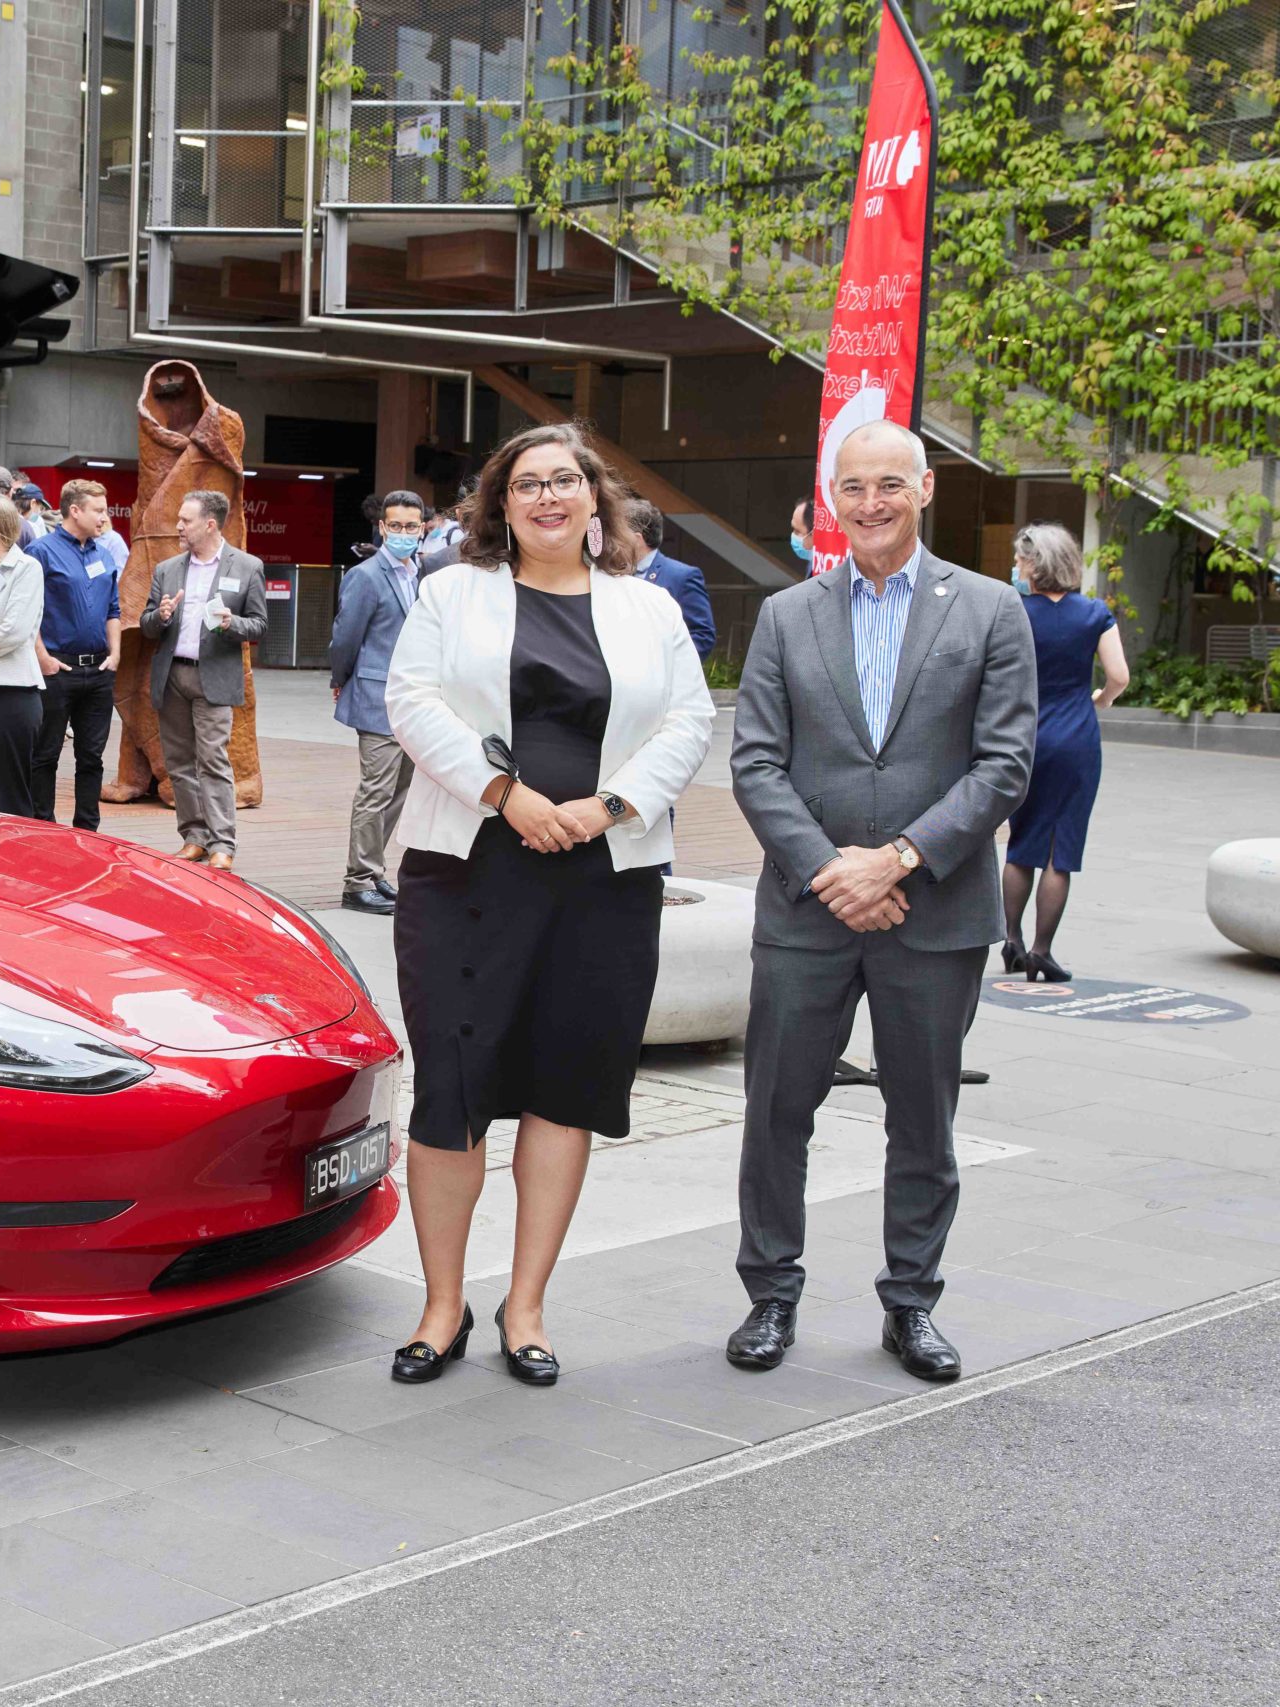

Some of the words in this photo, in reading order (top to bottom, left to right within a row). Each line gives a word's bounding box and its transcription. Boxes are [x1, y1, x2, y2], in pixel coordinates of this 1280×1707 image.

[108, 503, 132, 517] stra
[243, 500, 268, 516] 24/7
[251, 518, 287, 534] Locker
